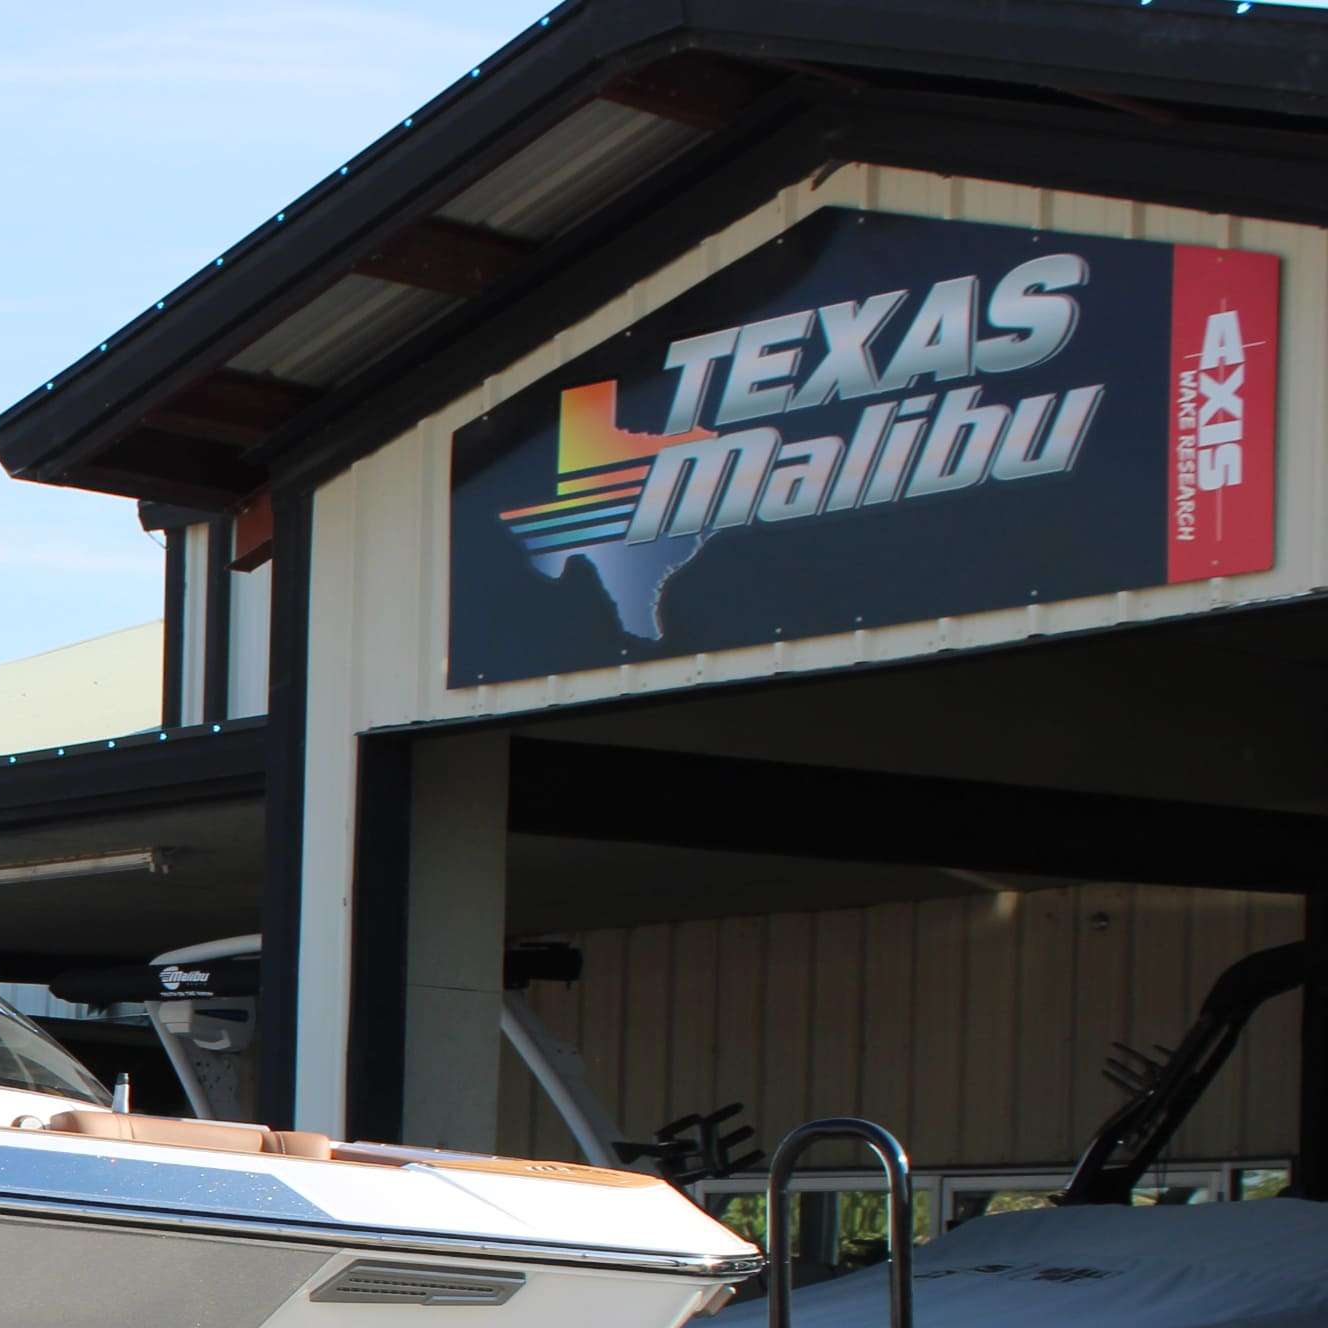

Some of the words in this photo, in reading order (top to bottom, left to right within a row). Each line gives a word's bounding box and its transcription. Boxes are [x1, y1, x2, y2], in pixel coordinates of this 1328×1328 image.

[662, 253, 1089, 436] TEXAS
[1177, 369, 1198, 431] WAKE
[1198, 310, 1246, 491] AXIS
[626, 383, 1104, 546] Malibu
[1176, 434, 1197, 541] RESEARCH
